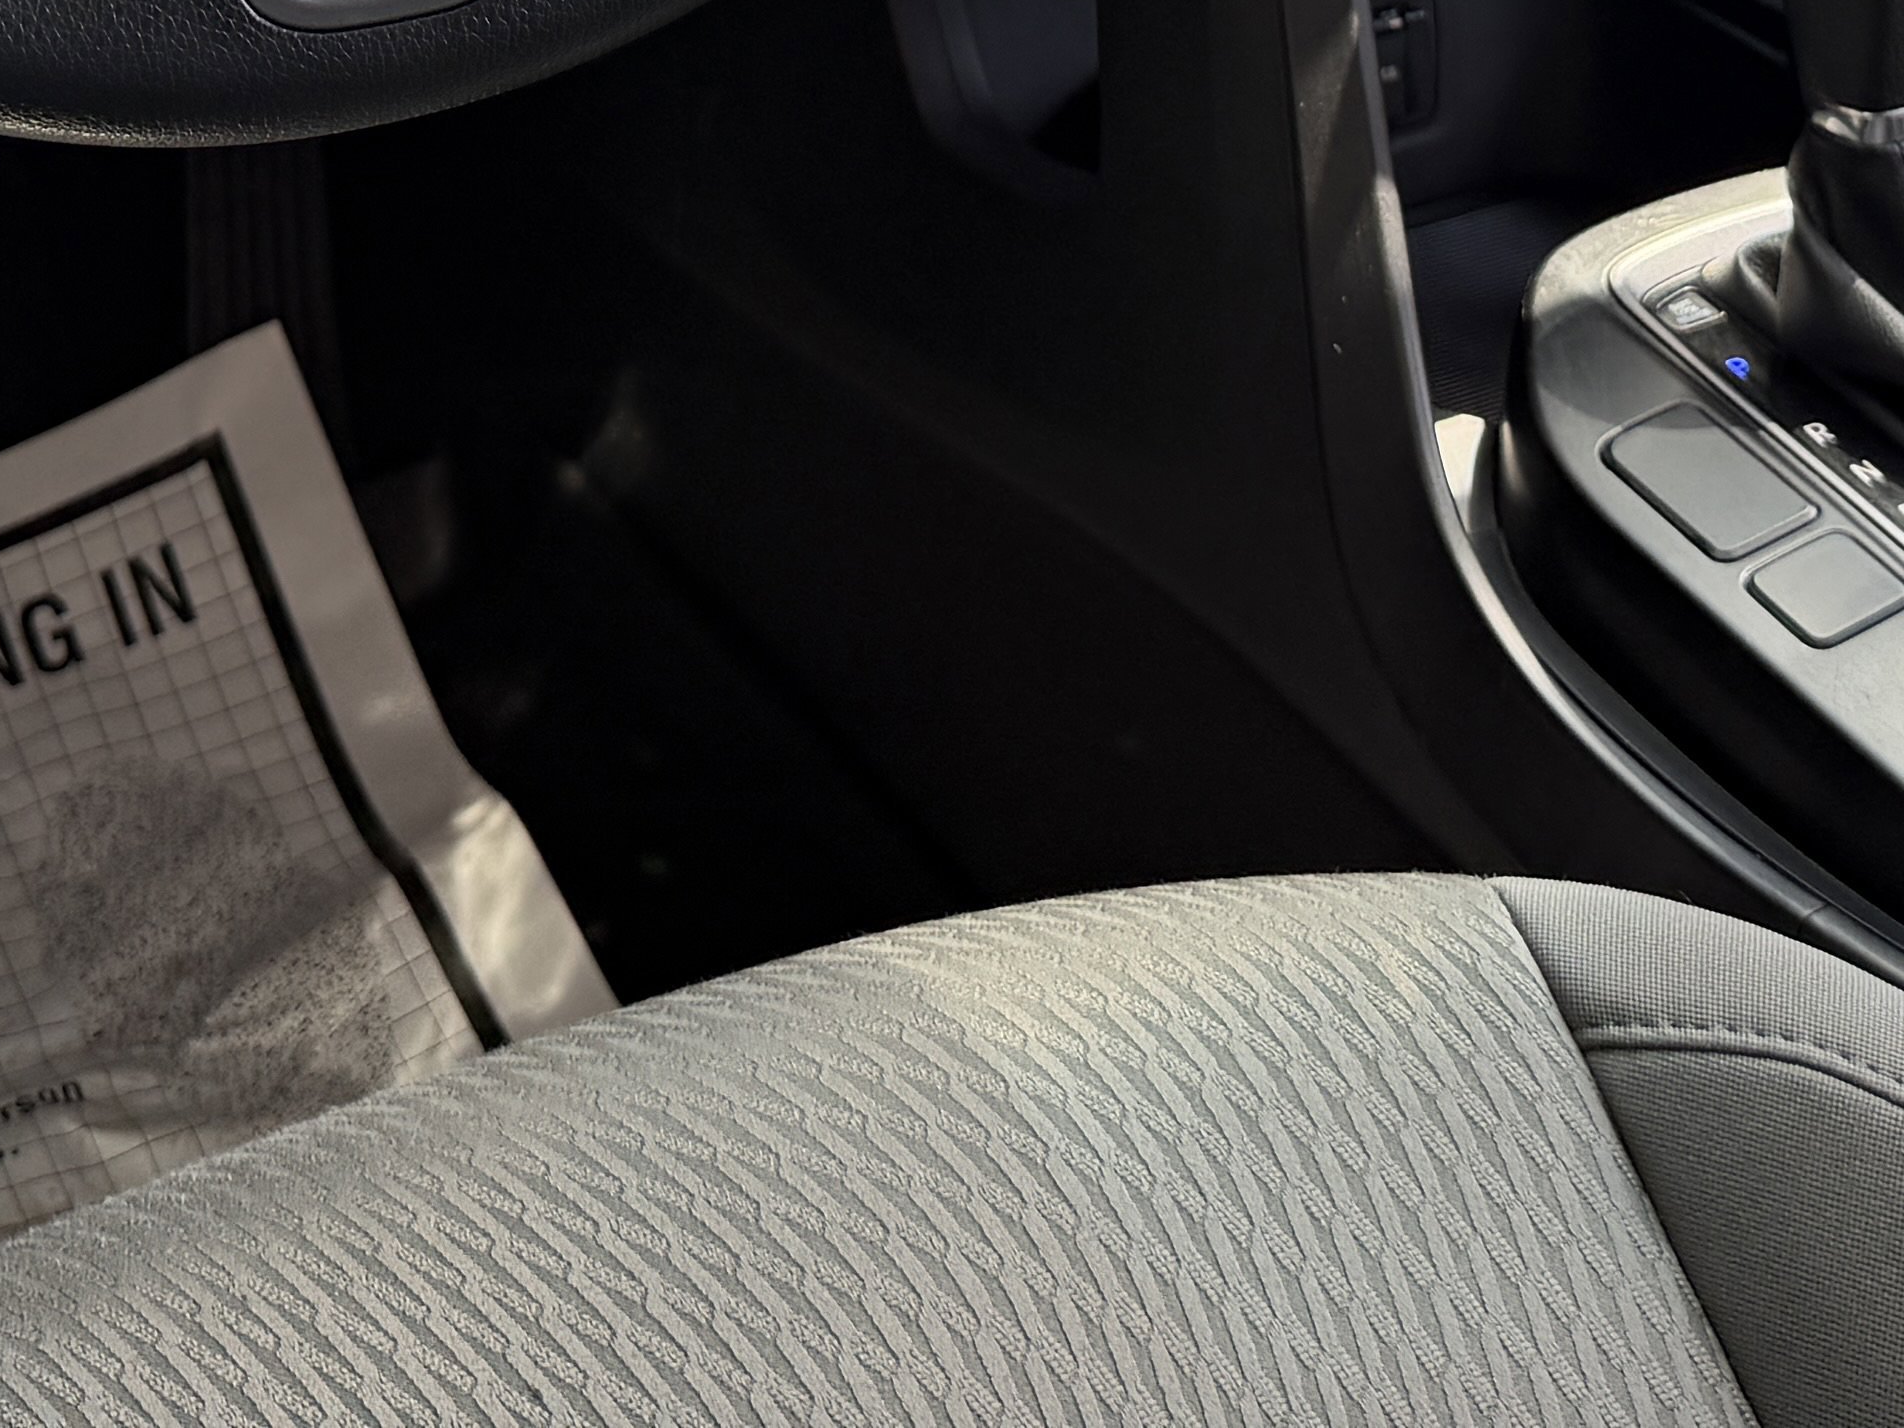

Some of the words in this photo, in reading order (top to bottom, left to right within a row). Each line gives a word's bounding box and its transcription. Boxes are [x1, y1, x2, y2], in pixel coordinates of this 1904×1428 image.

[1802, 421, 1838, 448] R
[1849, 459, 1886, 489] N
[106, 543, 199, 647] IN
